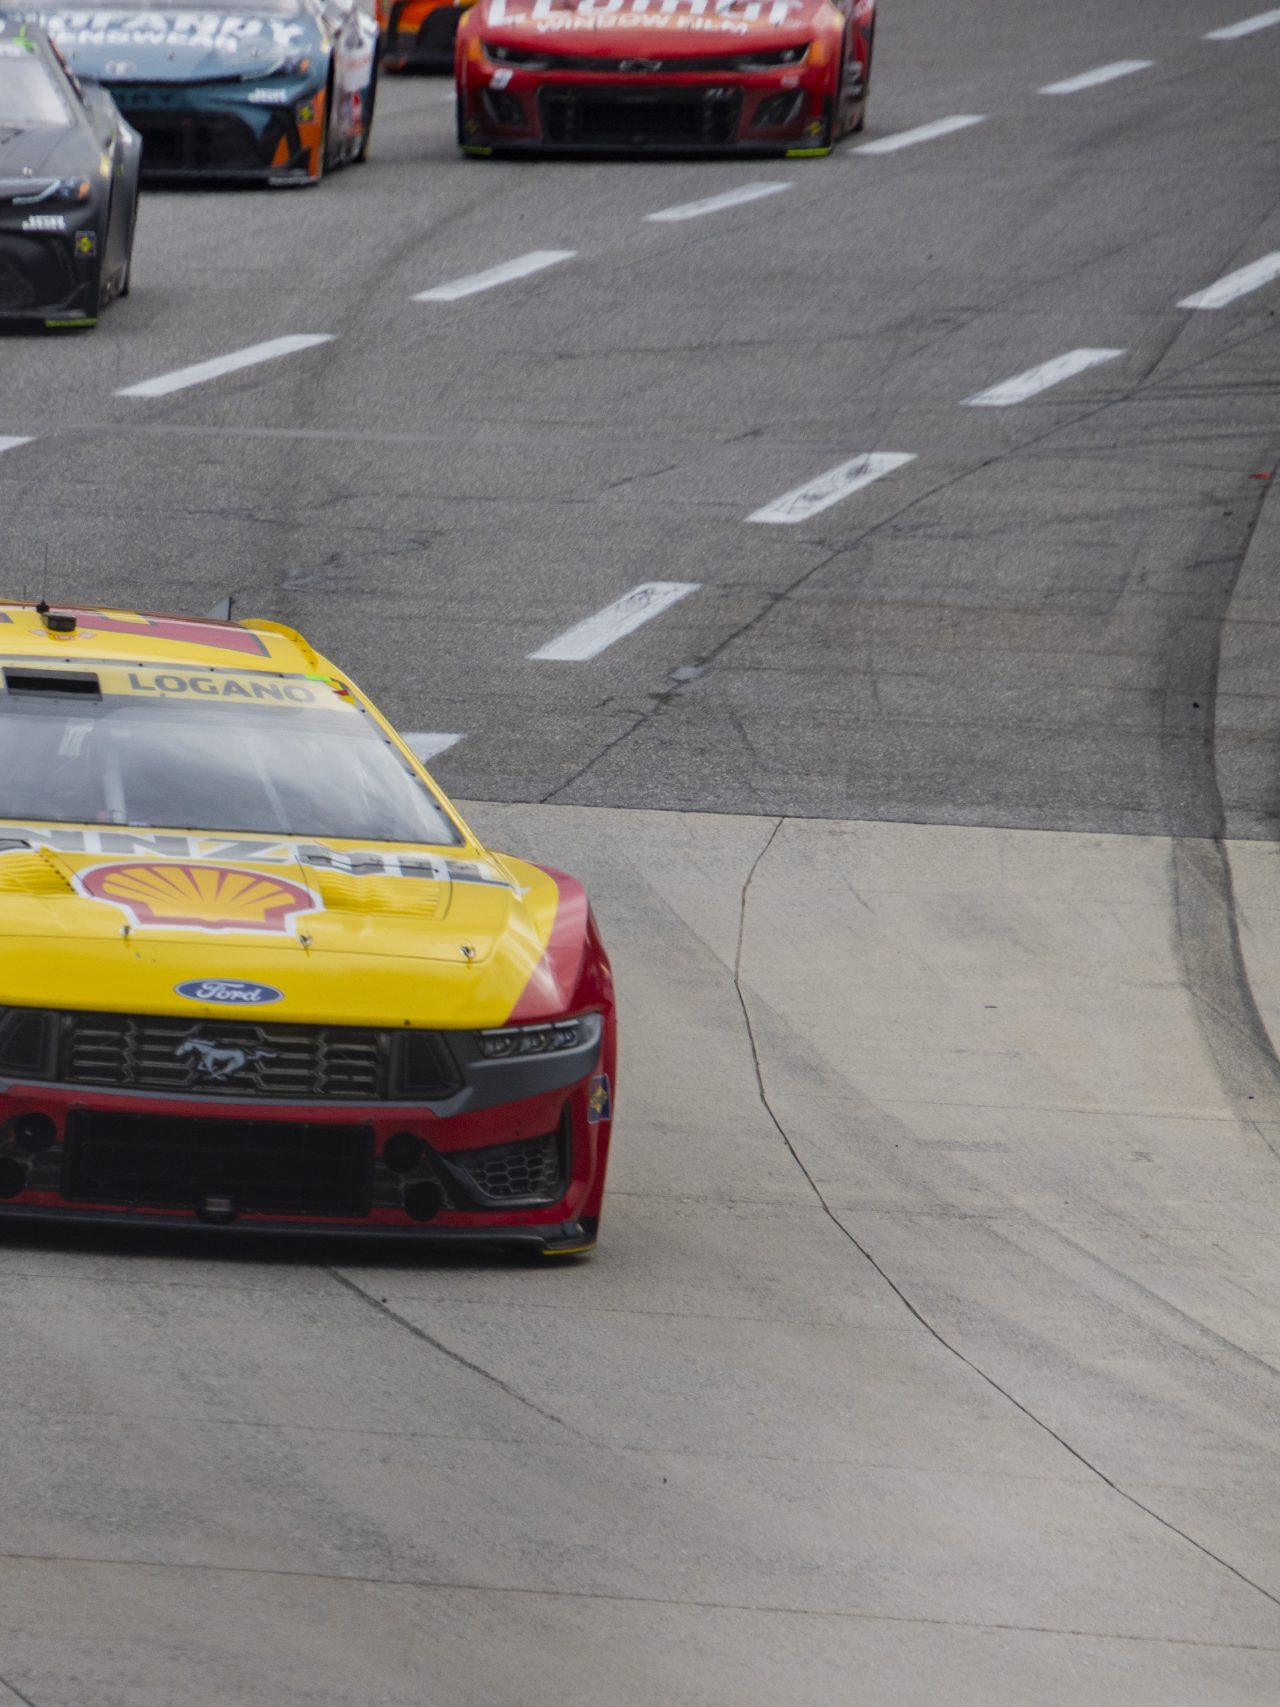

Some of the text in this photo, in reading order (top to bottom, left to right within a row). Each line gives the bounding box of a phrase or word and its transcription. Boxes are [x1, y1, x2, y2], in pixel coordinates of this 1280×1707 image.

[536, 12, 748, 35] WINDOW FILM
[127, 671, 317, 704] LOGANO
[191, 980, 266, 1003] Ford
